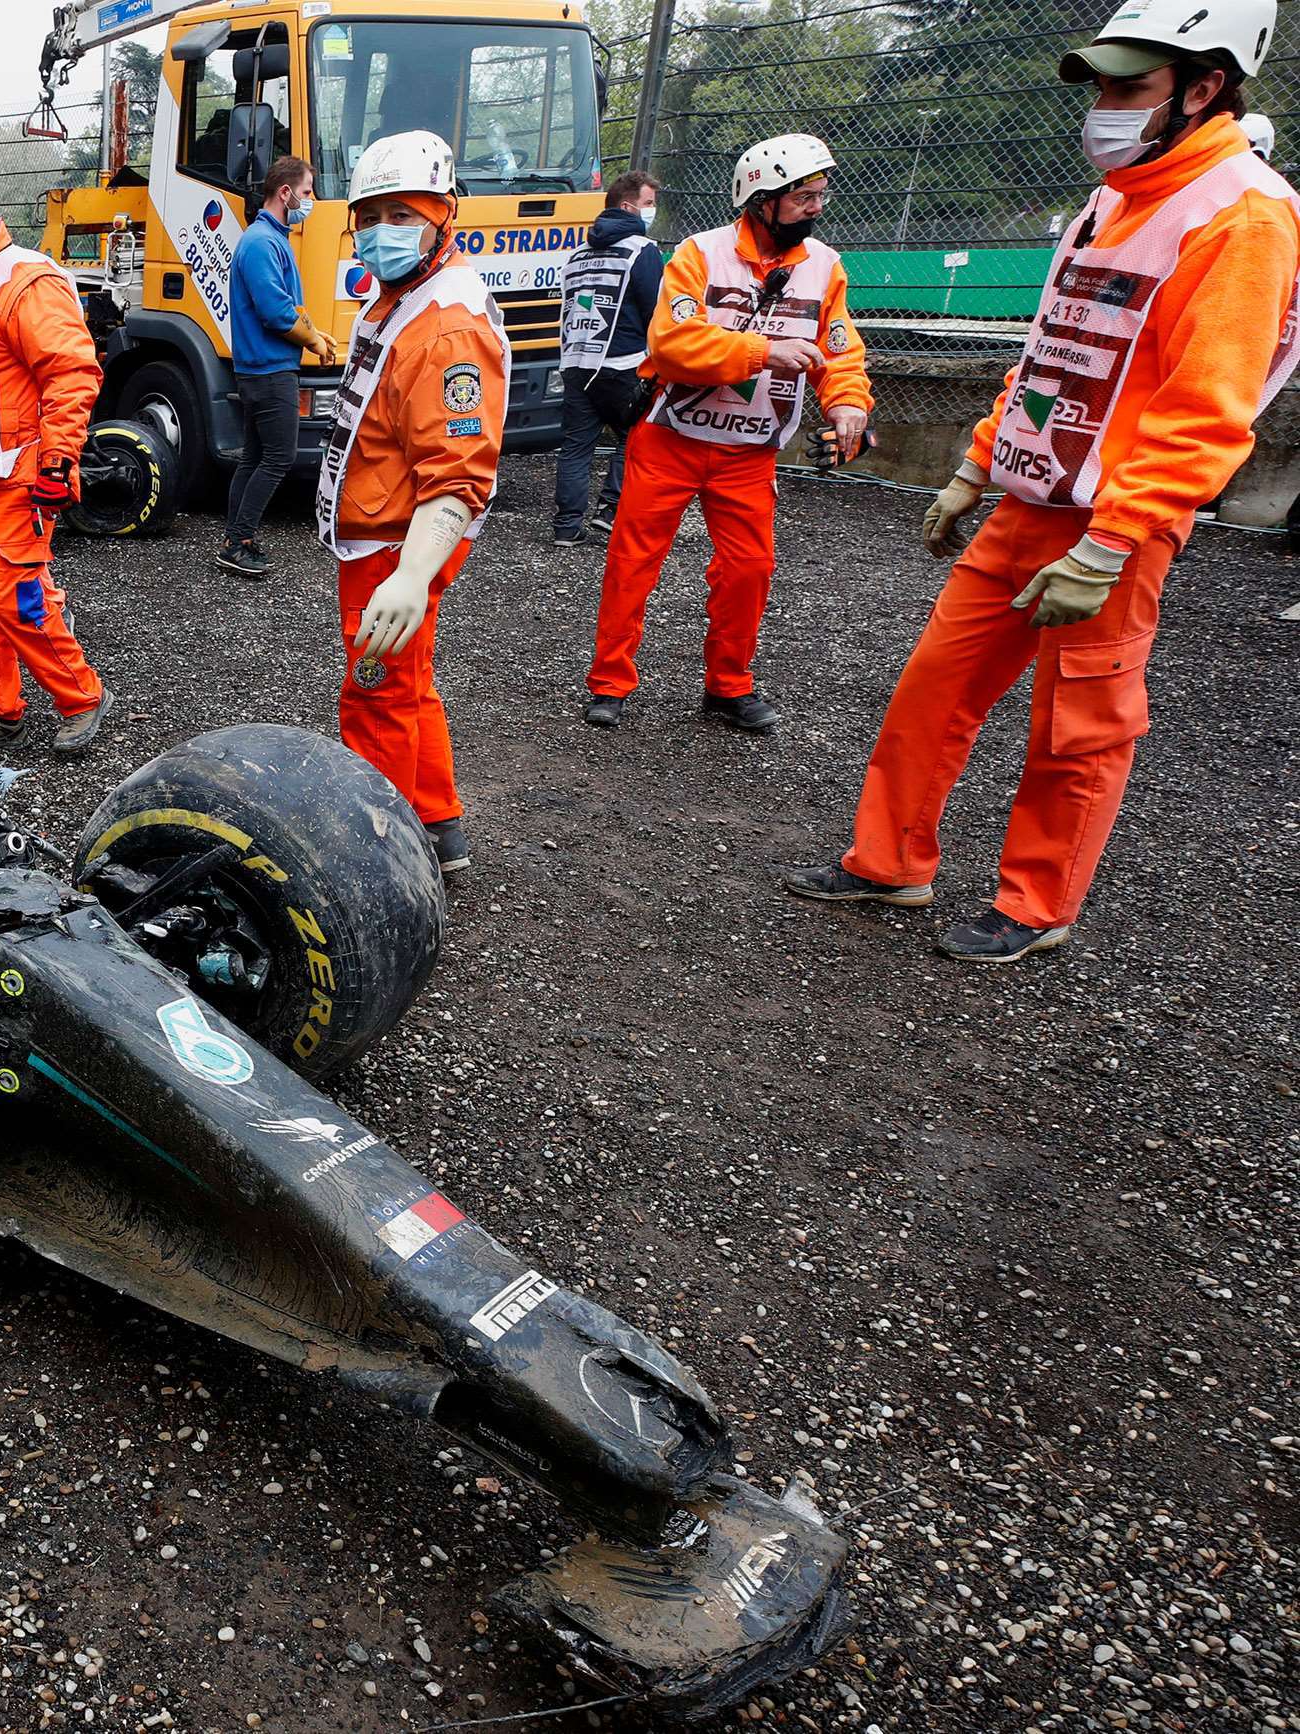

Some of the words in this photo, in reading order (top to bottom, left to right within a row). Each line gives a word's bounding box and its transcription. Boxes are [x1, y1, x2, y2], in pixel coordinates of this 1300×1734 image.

[193, 222, 229, 285] assistance
[214, 233, 232, 264] euro
[185, 243, 229, 322] 803.803
[677, 408, 772, 435] COURSE
[242, 854, 290, 883] P
[287, 905, 336, 1058] ZERO
[302, 1134, 380, 1184] CROWDSTRIKE
[371, 1184, 429, 1224] TOMMY
[416, 1222, 476, 1265] HILFIGER
[469, 1269, 560, 1342] PIRELLI
